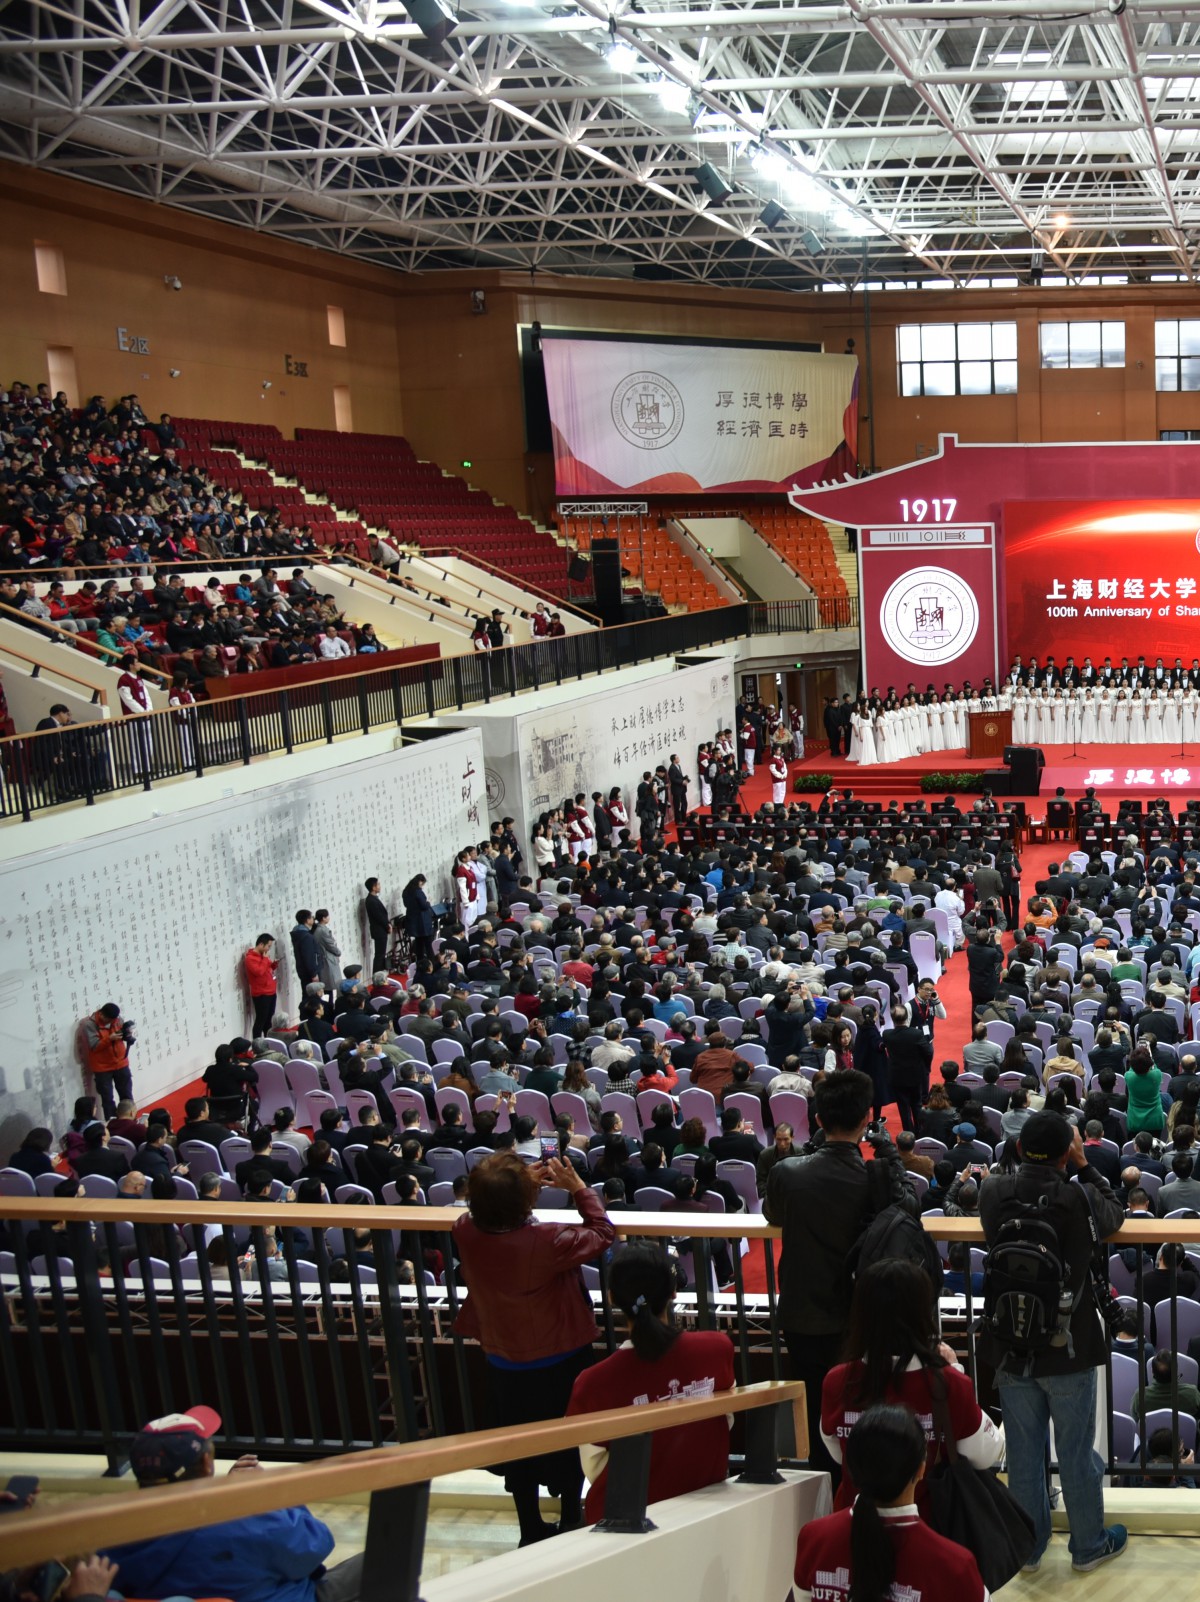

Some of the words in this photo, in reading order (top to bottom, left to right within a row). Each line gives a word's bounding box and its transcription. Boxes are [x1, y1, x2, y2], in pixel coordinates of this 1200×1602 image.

[899, 498, 958, 523] 1917
[1046, 606, 1078, 618] 100th
[1084, 605, 1152, 619] Anniversary
[1158, 605, 1170, 617] of
